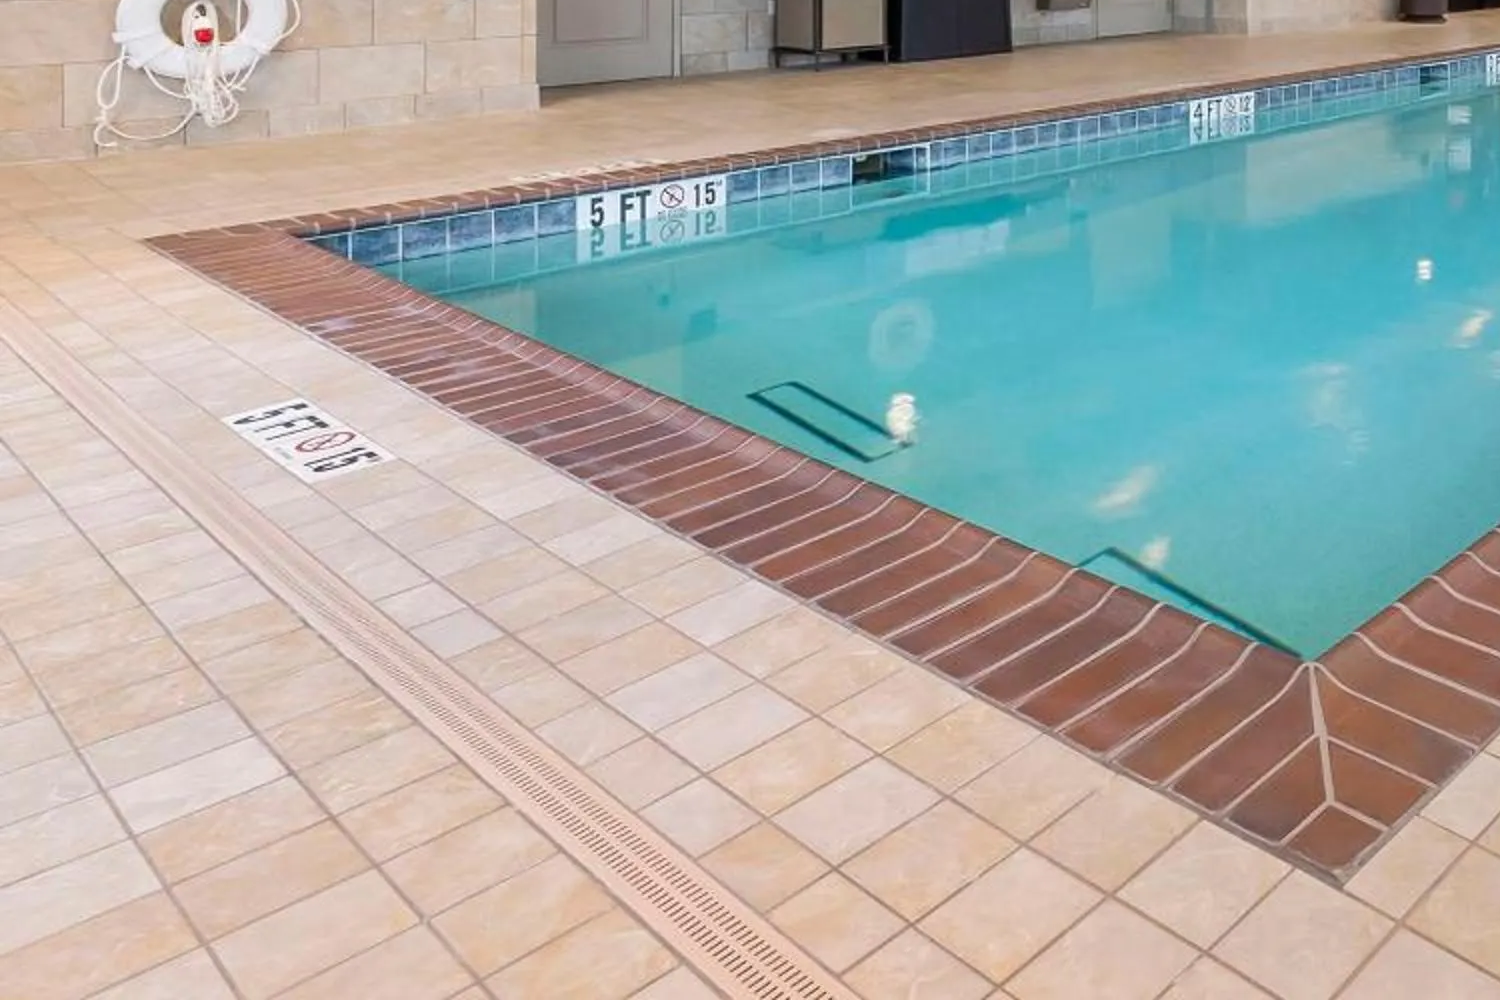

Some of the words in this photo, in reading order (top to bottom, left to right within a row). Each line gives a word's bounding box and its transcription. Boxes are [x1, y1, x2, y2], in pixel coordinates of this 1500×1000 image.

[1193, 102, 1203, 119] 4
[1207, 99, 1223, 119] FT
[590, 196, 605, 227] 5
[620, 189, 652, 223] FT
[233, 403, 308, 424] 5
[254, 415, 330, 441] FT
